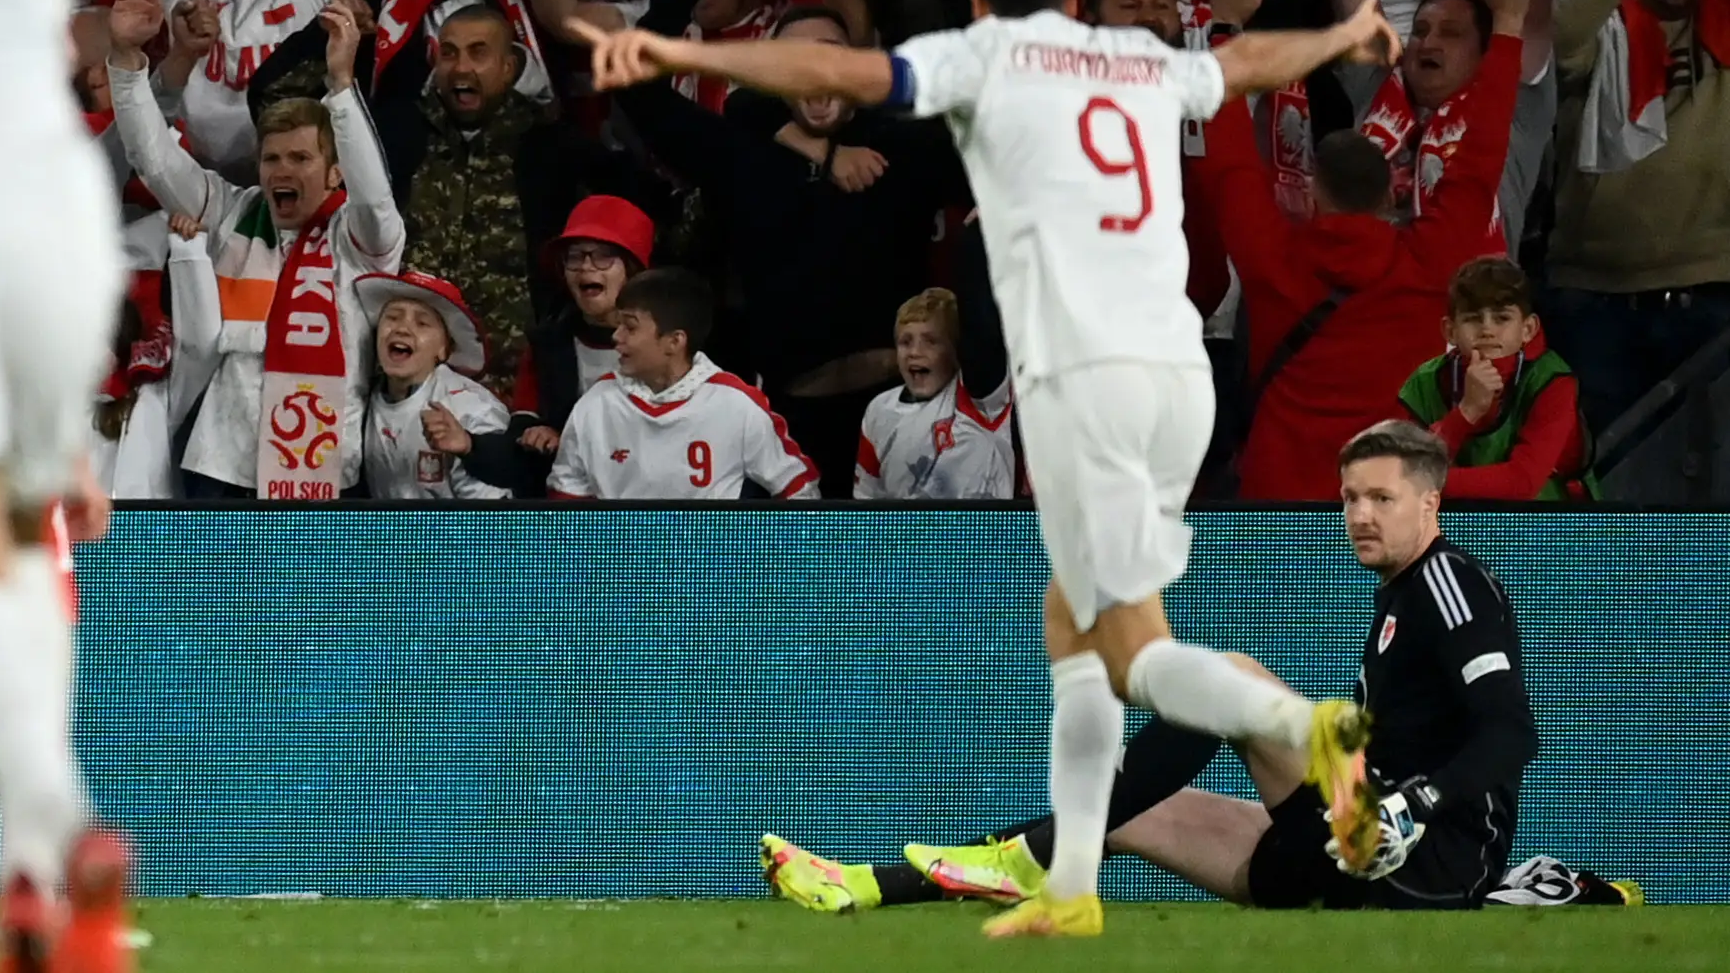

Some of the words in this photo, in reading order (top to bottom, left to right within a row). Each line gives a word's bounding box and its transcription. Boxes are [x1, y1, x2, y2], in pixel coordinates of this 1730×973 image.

[1077, 96, 1154, 233] 9
[687, 440, 713, 488] 9
[268, 480, 334, 500] POLSKA
